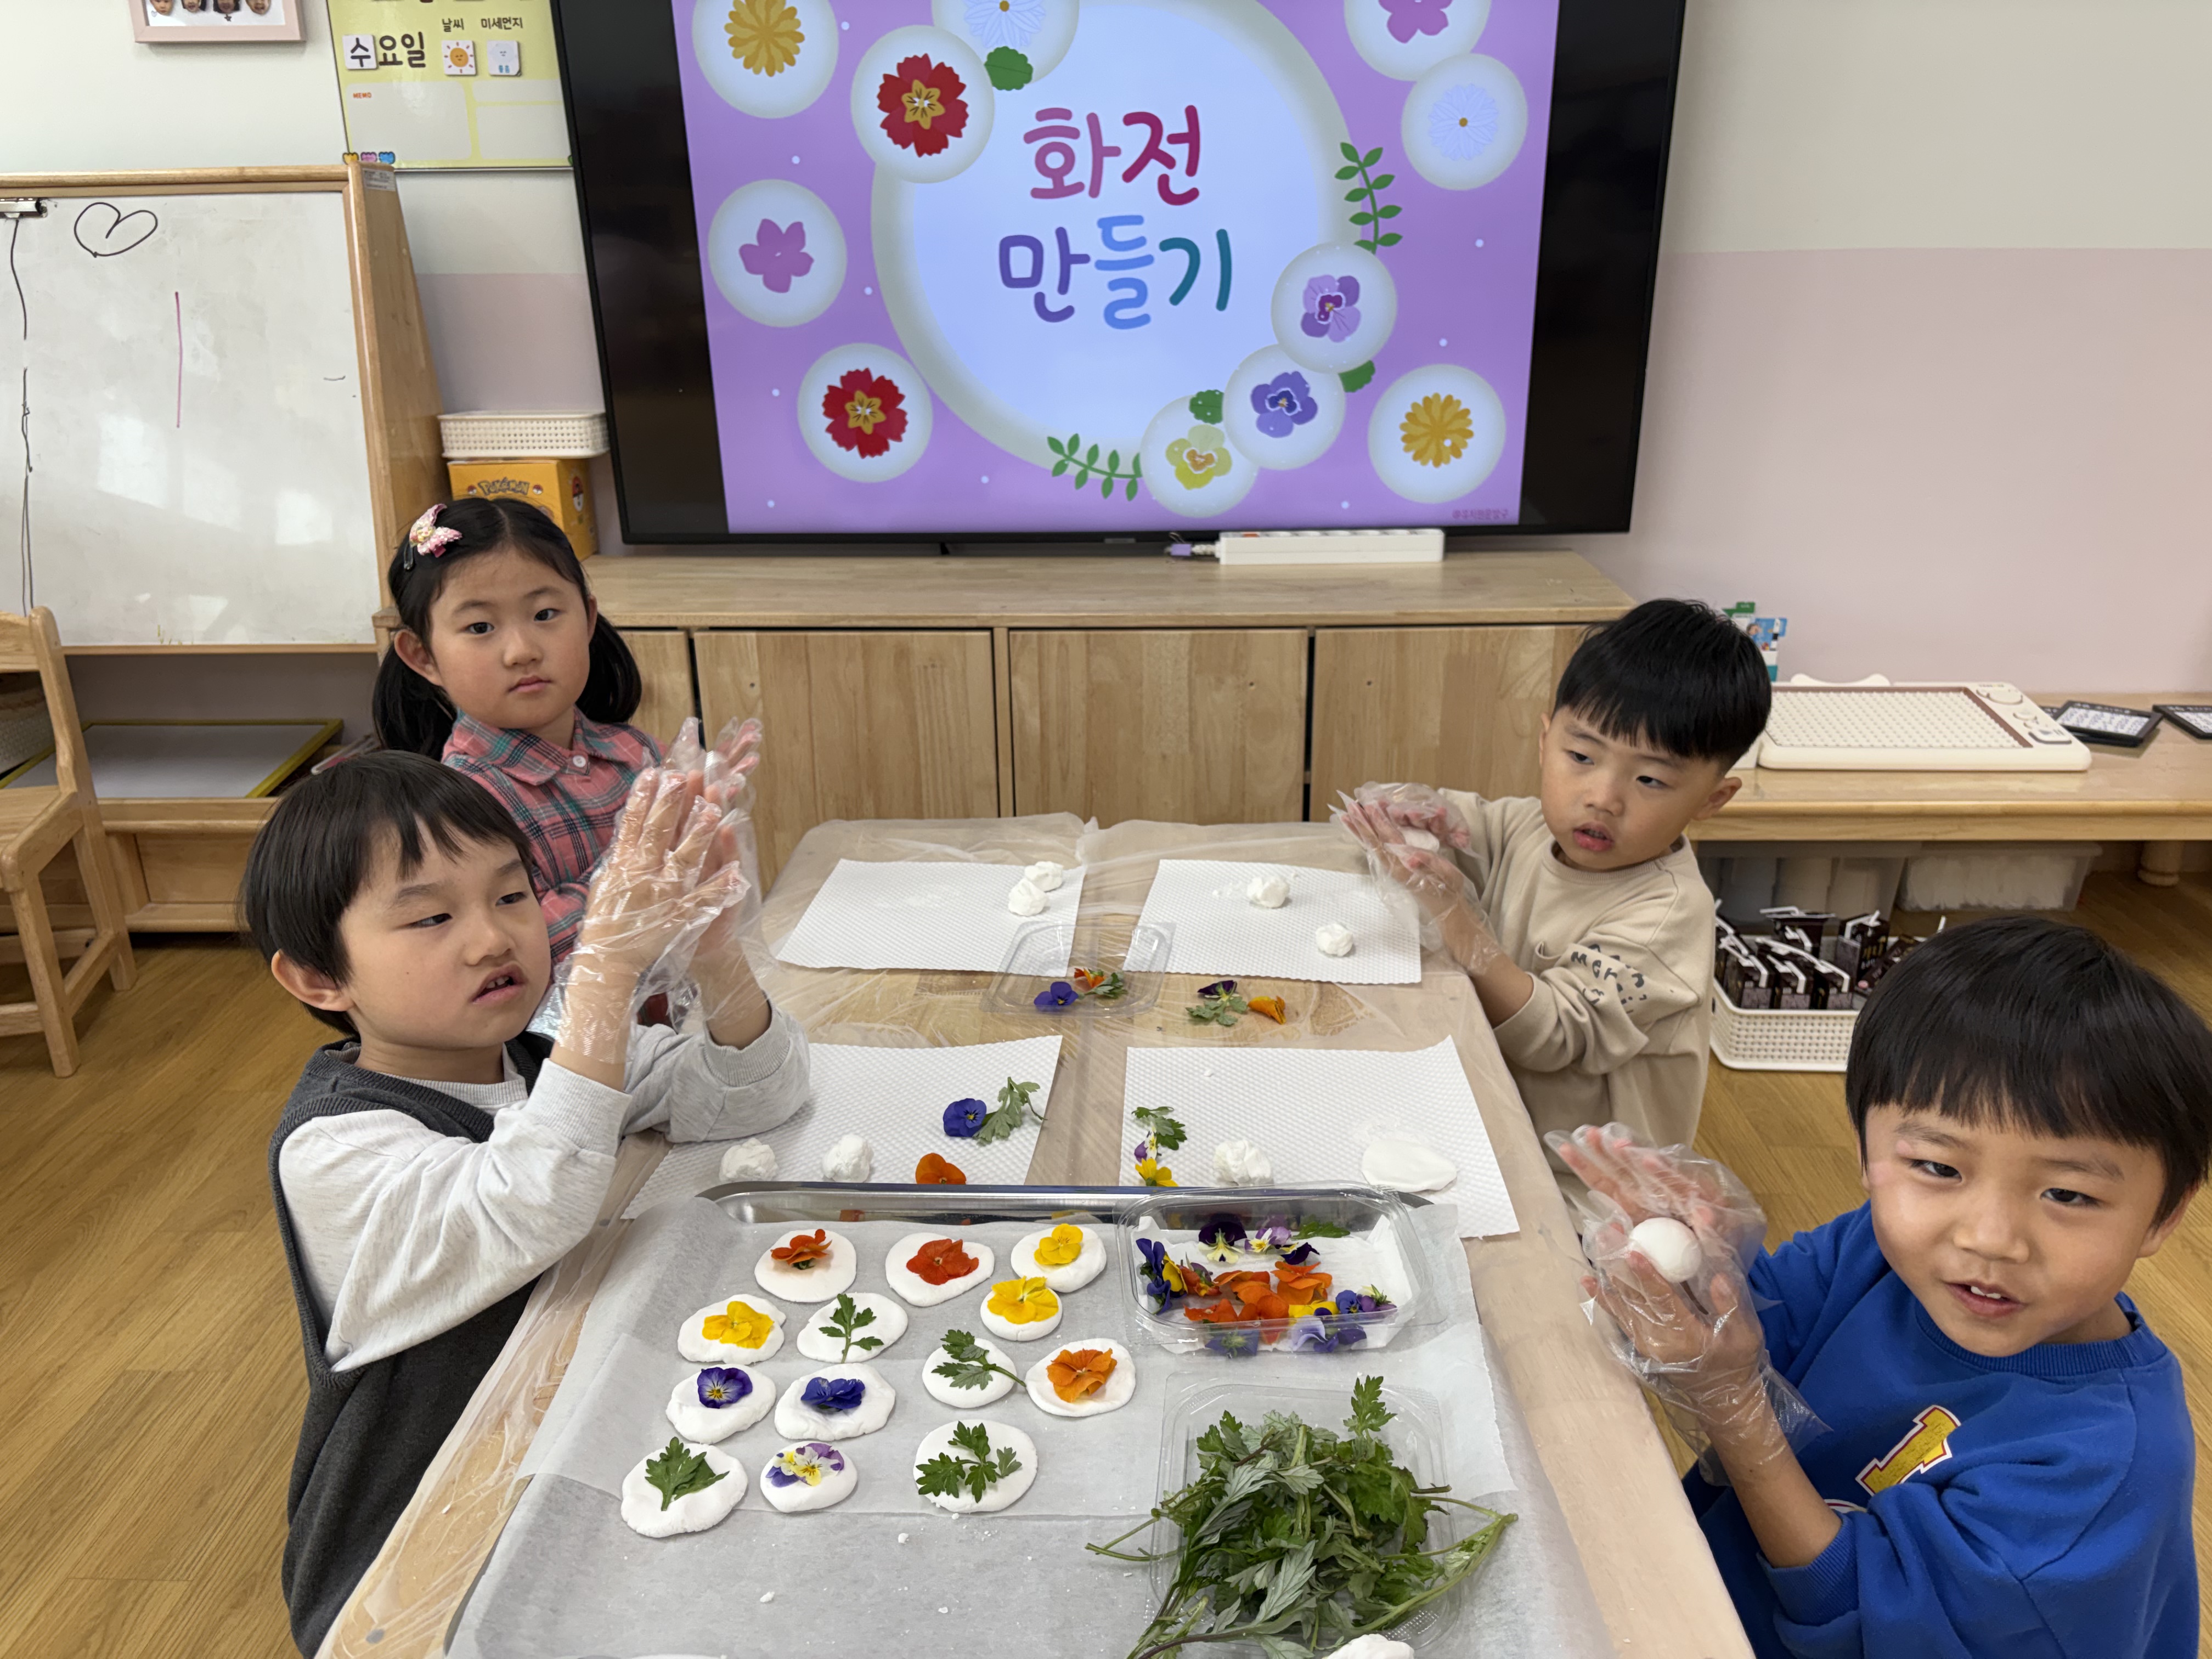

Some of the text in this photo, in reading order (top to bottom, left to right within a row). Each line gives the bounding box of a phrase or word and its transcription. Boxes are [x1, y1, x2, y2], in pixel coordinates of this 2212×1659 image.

[350, 31, 426, 68] 수요일
[442, 16, 523, 32] 날씨 미세먼지
[1023, 105, 1201, 206] 화전
[999, 215, 1232, 330] 만들기
